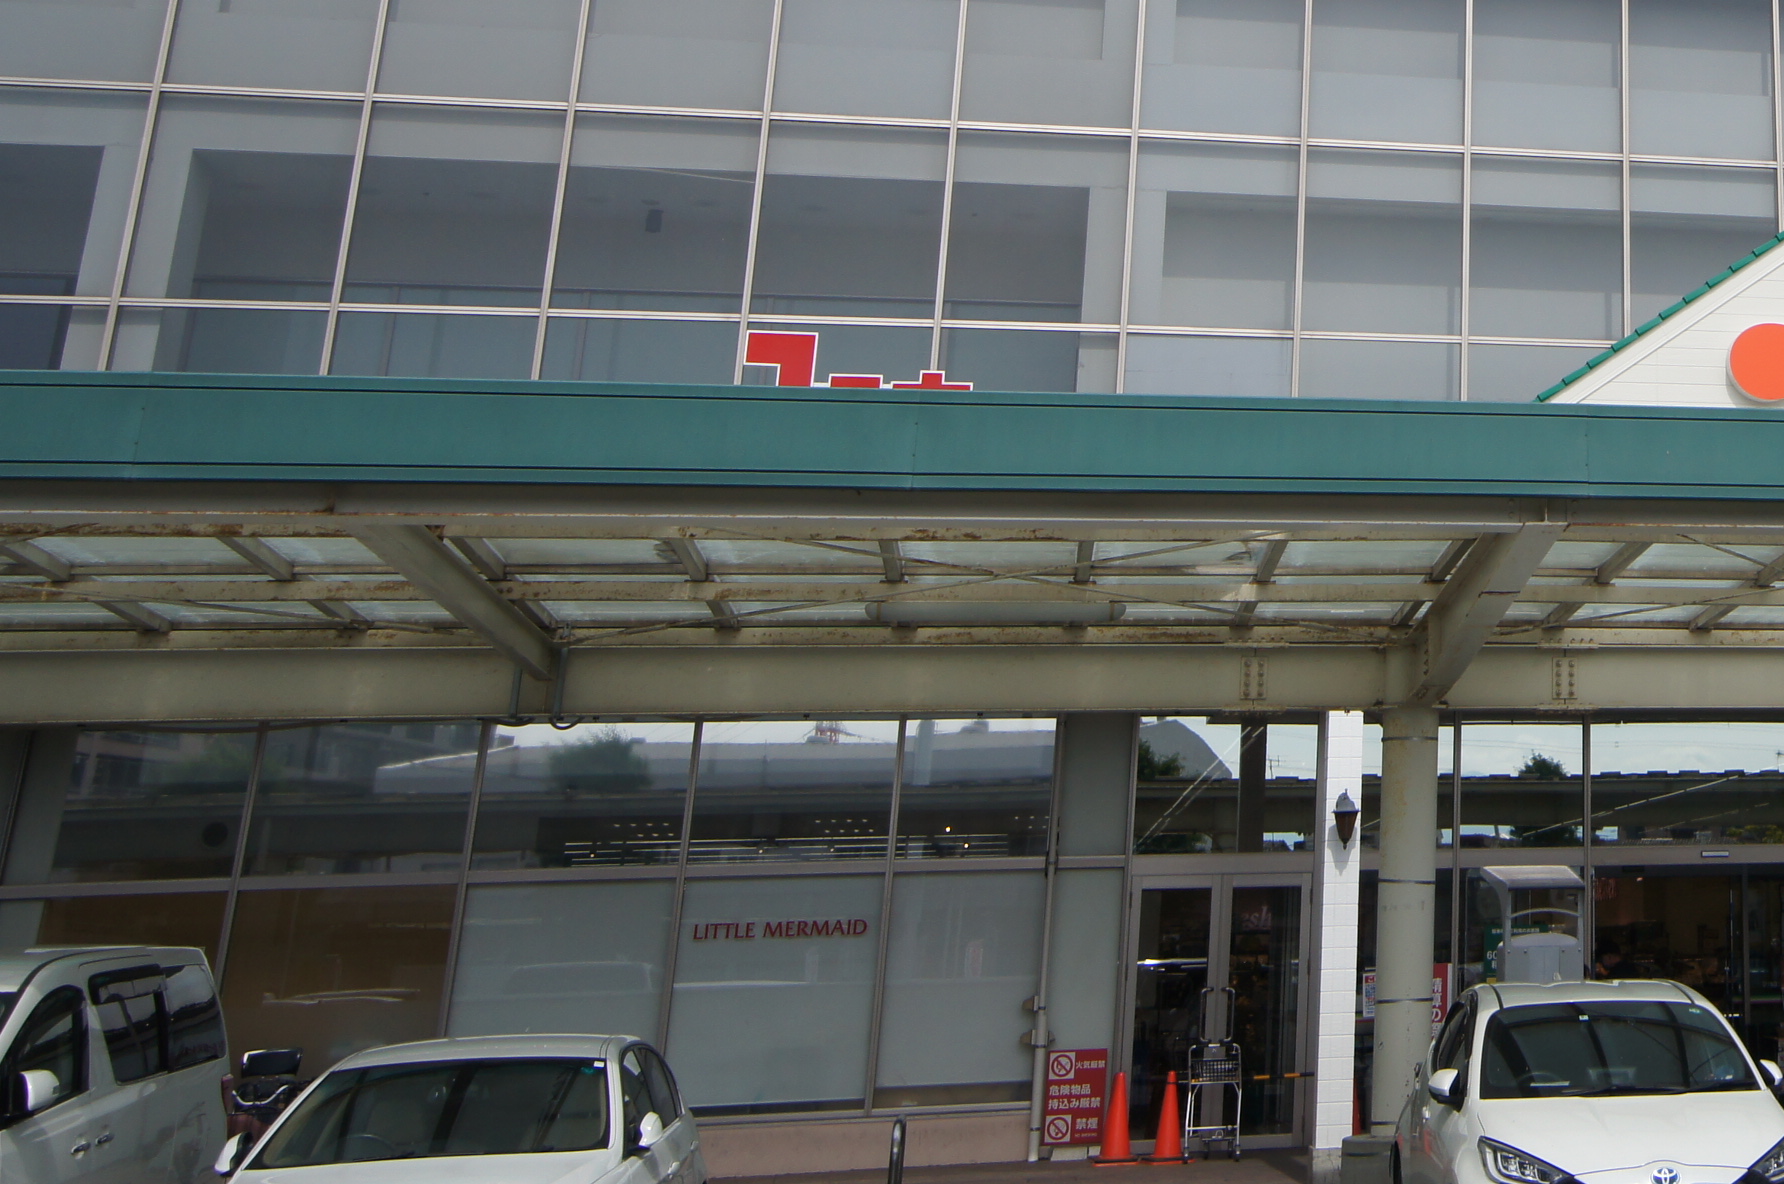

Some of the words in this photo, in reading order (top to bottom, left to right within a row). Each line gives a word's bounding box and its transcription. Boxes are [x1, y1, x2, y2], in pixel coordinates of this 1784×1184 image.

[692, 921, 756, 940] LITTLE
[762, 919, 868, 938] MERMAID
[1049, 1083, 1091, 1096] 危険物品
[1047, 1097, 1101, 1110] 持込み厳禁
[1075, 1117, 1098, 1130] 禁煙
